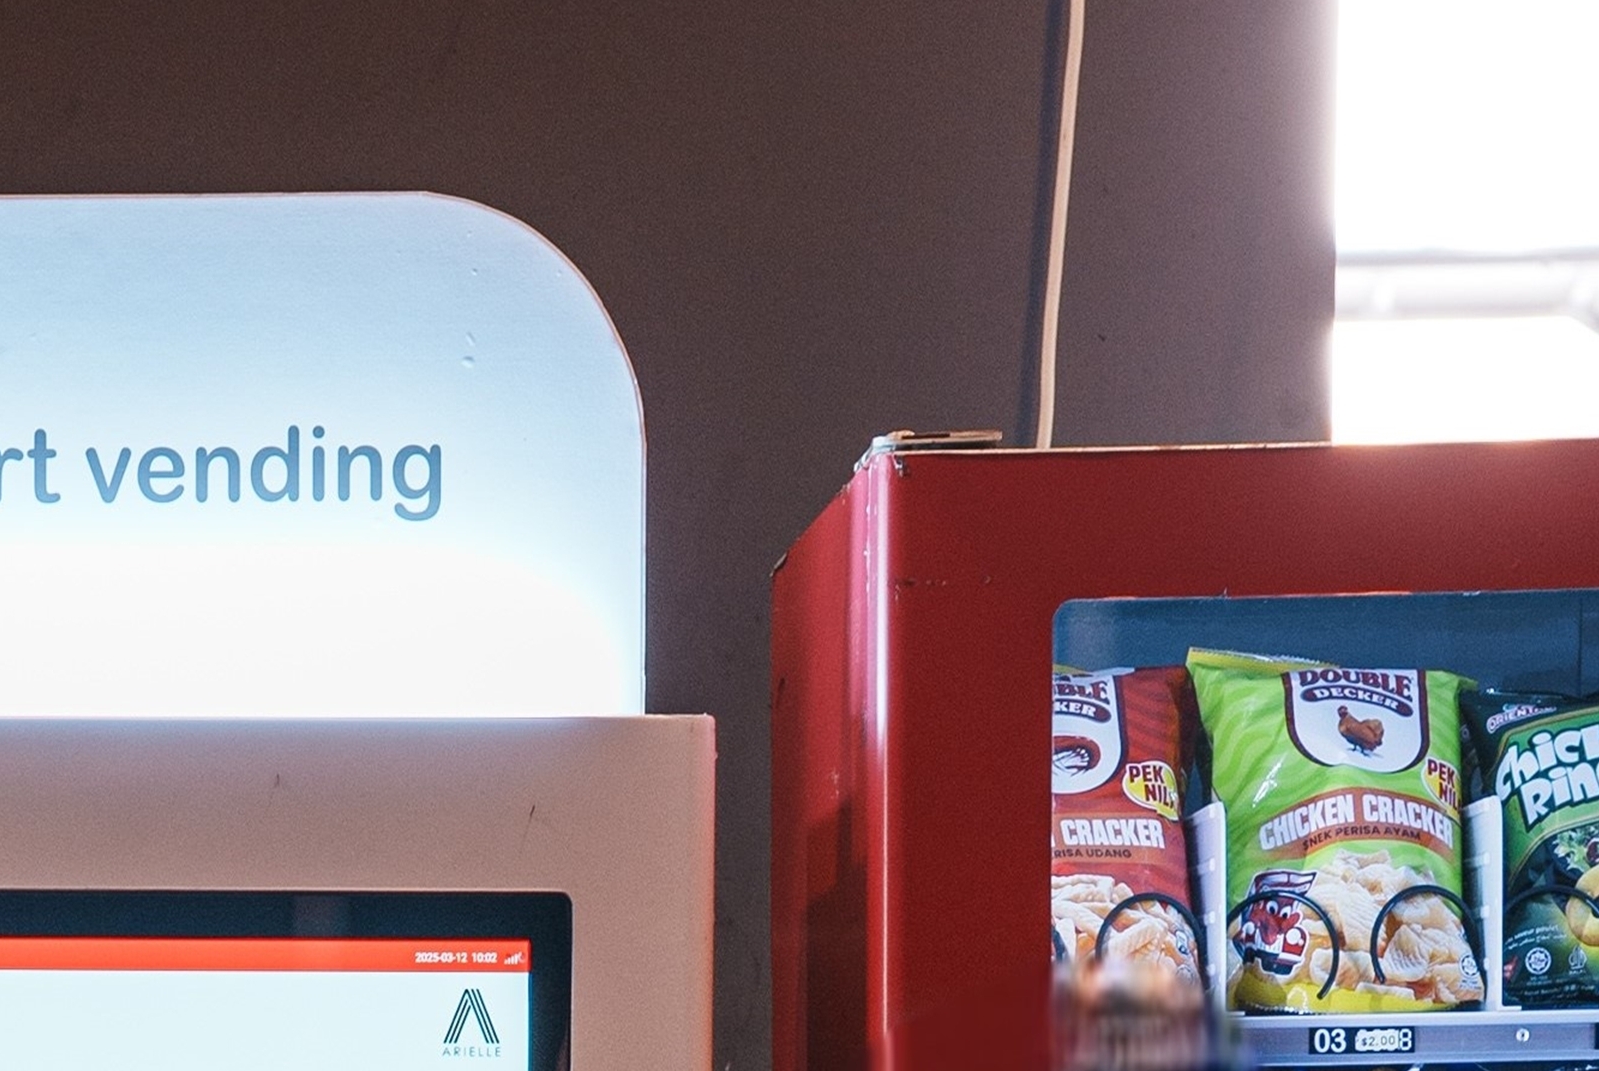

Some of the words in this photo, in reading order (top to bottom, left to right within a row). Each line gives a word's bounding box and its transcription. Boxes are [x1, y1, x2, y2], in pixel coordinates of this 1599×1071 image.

[85, 424, 444, 523] vending
[1298, 668, 1413, 703] DOUBLE
[1314, 686, 1400, 710] DECKER
[1128, 765, 1165, 784] PEK
[1060, 819, 1166, 848] CRACKER
[1259, 793, 1356, 851] CHICKEN
[1362, 793, 1454, 850] CRACKER
[1335, 825, 1381, 839] PERISA
[1383, 826, 1421, 841] AYAM
[1086, 849, 1132, 859] UDANG
[414, 951, 468, 964] 2025-03-12
[471, 951, 498, 964] 10:02
[442, 1046, 502, 1058] ARIELLE
[1313, 1028, 1347, 1053] 03
